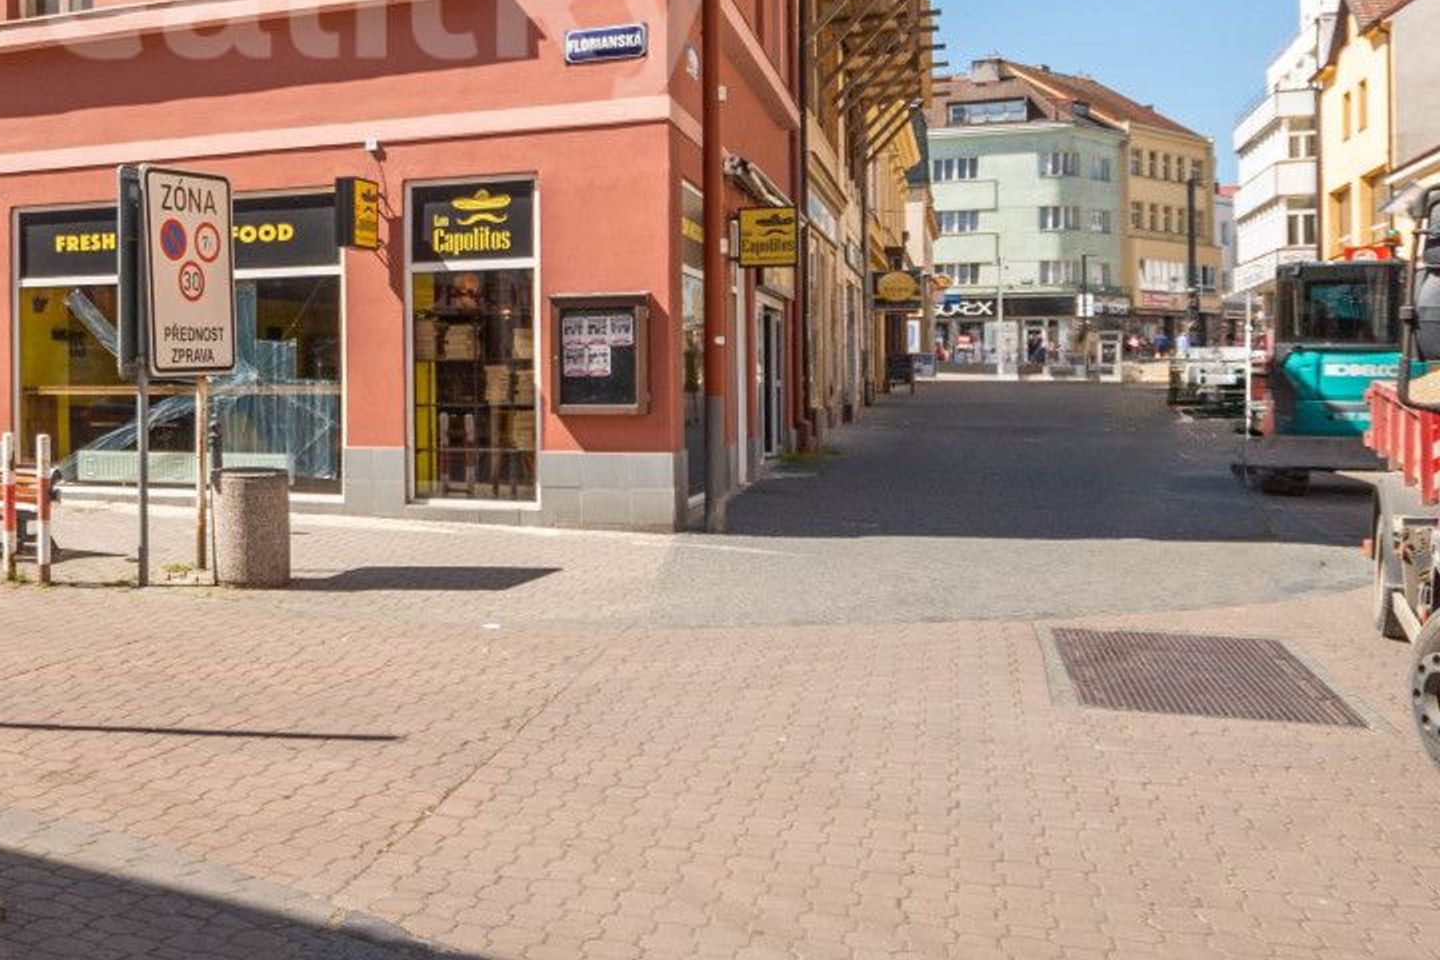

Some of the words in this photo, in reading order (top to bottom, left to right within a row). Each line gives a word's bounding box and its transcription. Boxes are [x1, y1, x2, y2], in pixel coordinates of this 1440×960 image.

[161, 178, 217, 215] ZÓNA
[55, 232, 116, 253] FRESH
[433, 226, 512, 256] Capolitos
[183, 271, 200, 292] 30
[164, 323, 224, 341] PŘEDNOST
[172, 348, 215, 363] ZPRAVA
